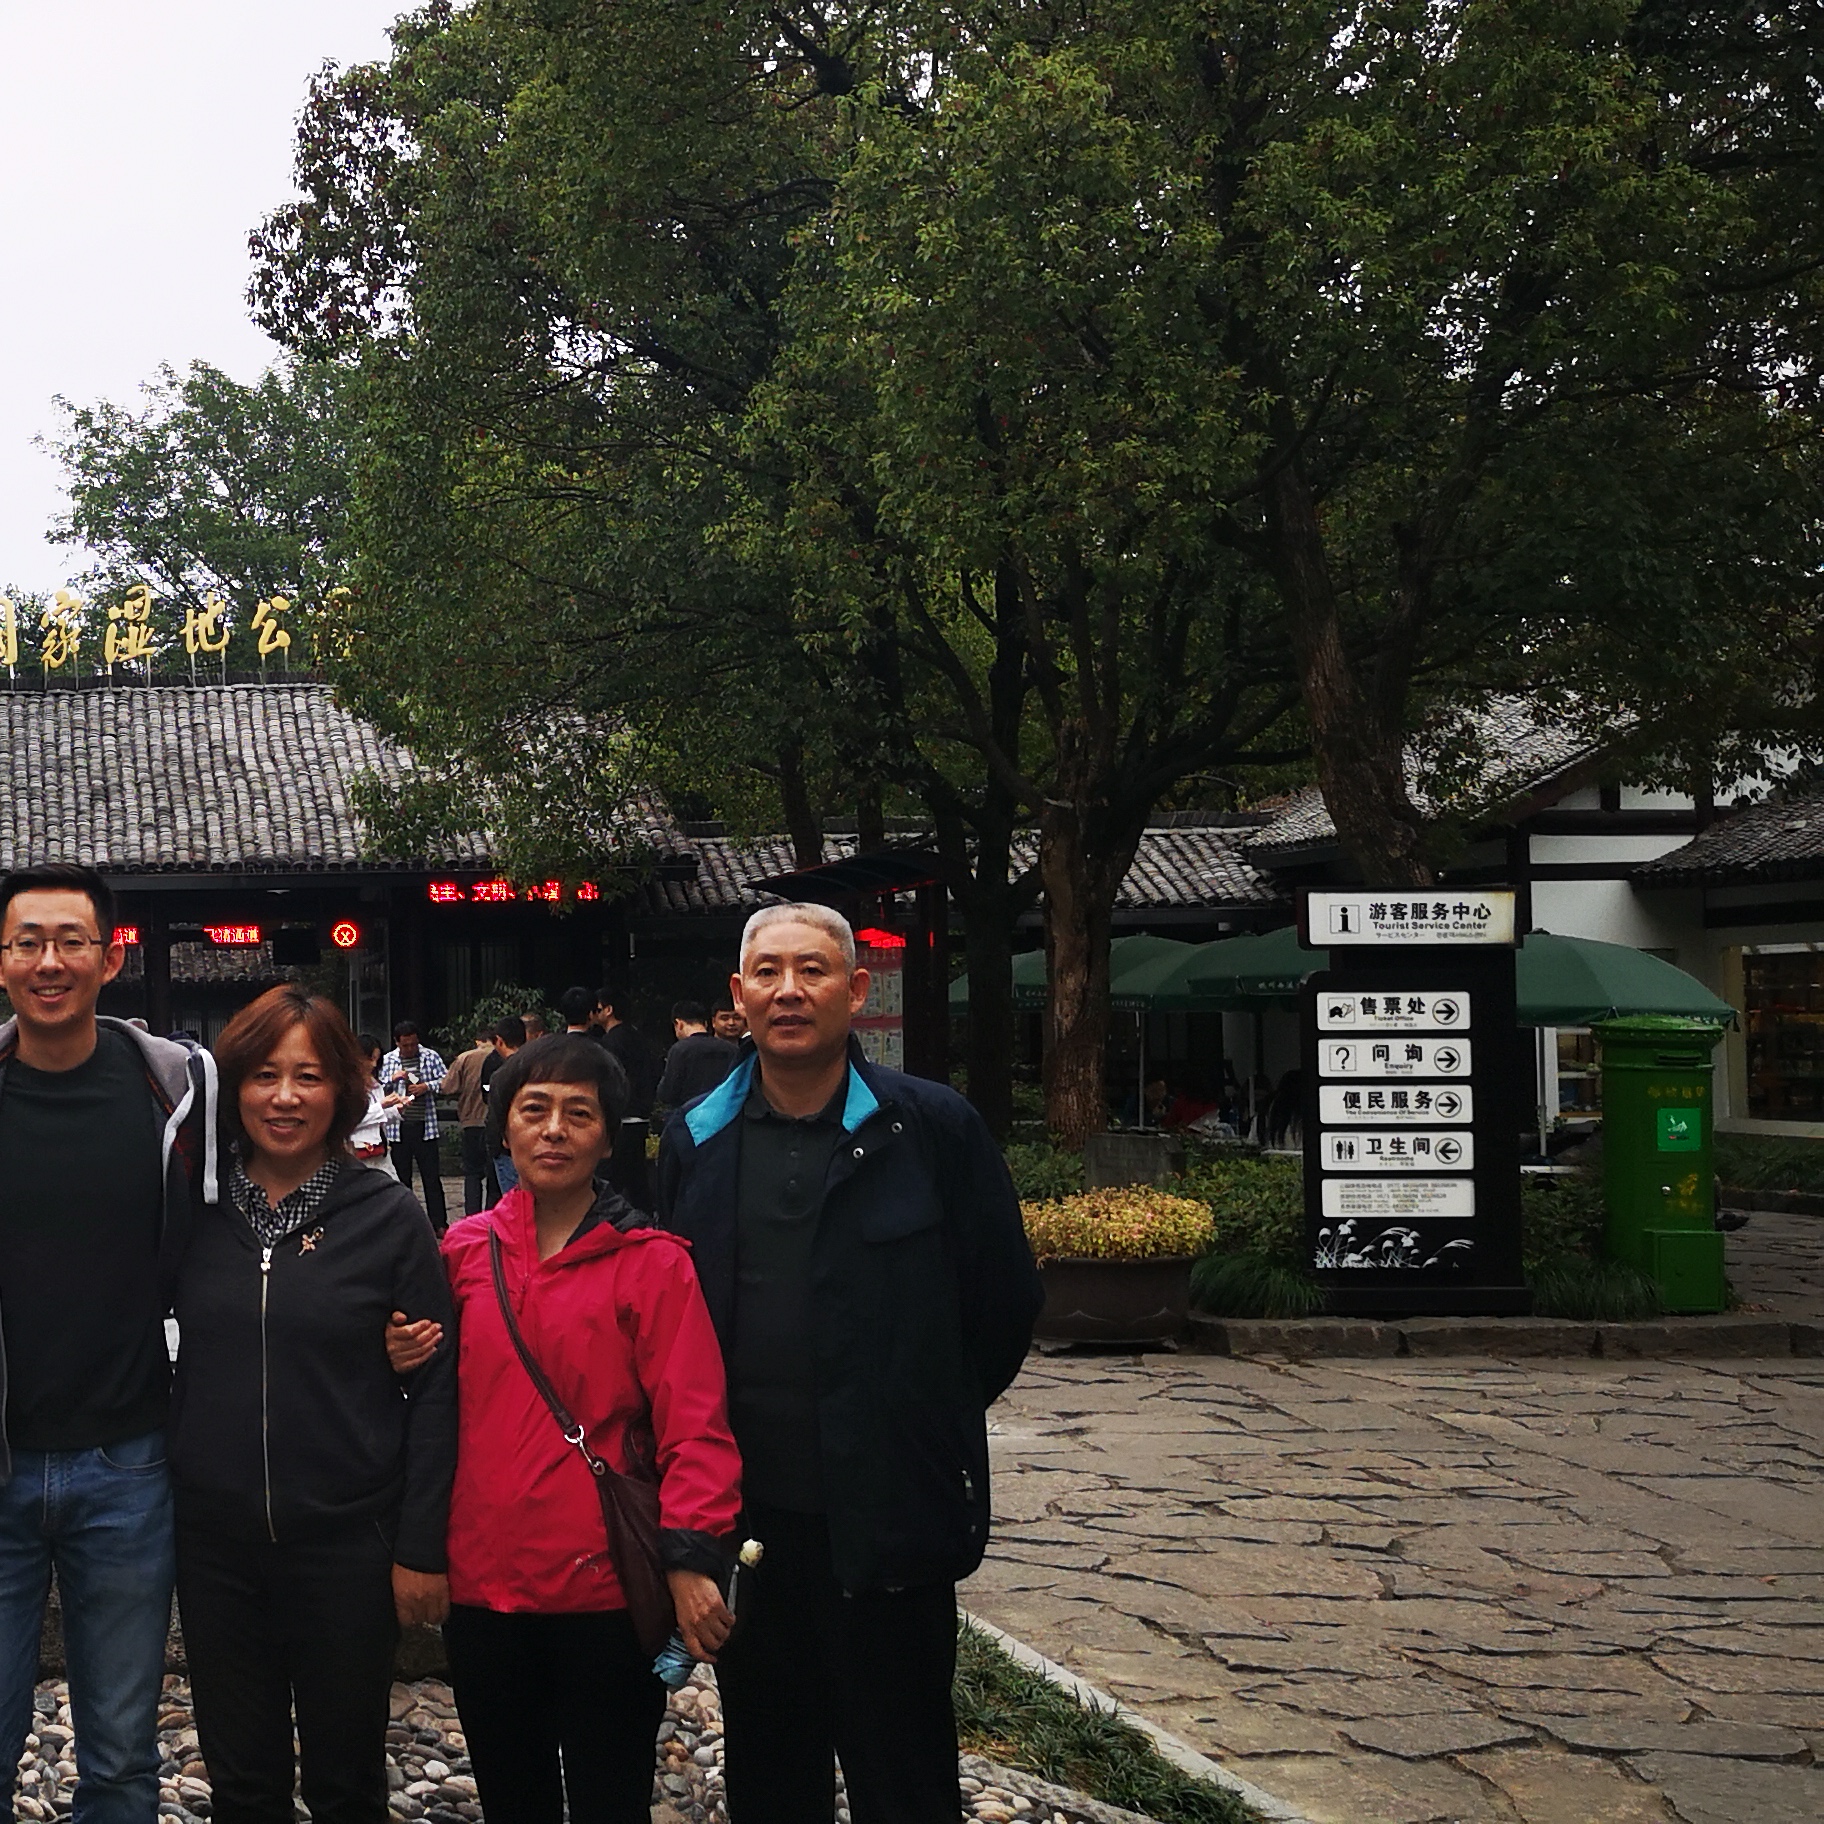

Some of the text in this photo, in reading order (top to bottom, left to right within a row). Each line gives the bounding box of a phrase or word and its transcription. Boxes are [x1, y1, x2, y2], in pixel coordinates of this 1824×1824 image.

[1369, 902, 1491, 920] 游客服务中心
[1373, 921, 1487, 930] Tourist Service Center
[1360, 997, 1426, 1015] 售票处
[1384, 1062, 1413, 1070] Enquiry
[1343, 1091, 1433, 1109] 便民服务
[1366, 1138, 1431, 1155] 卫生间
